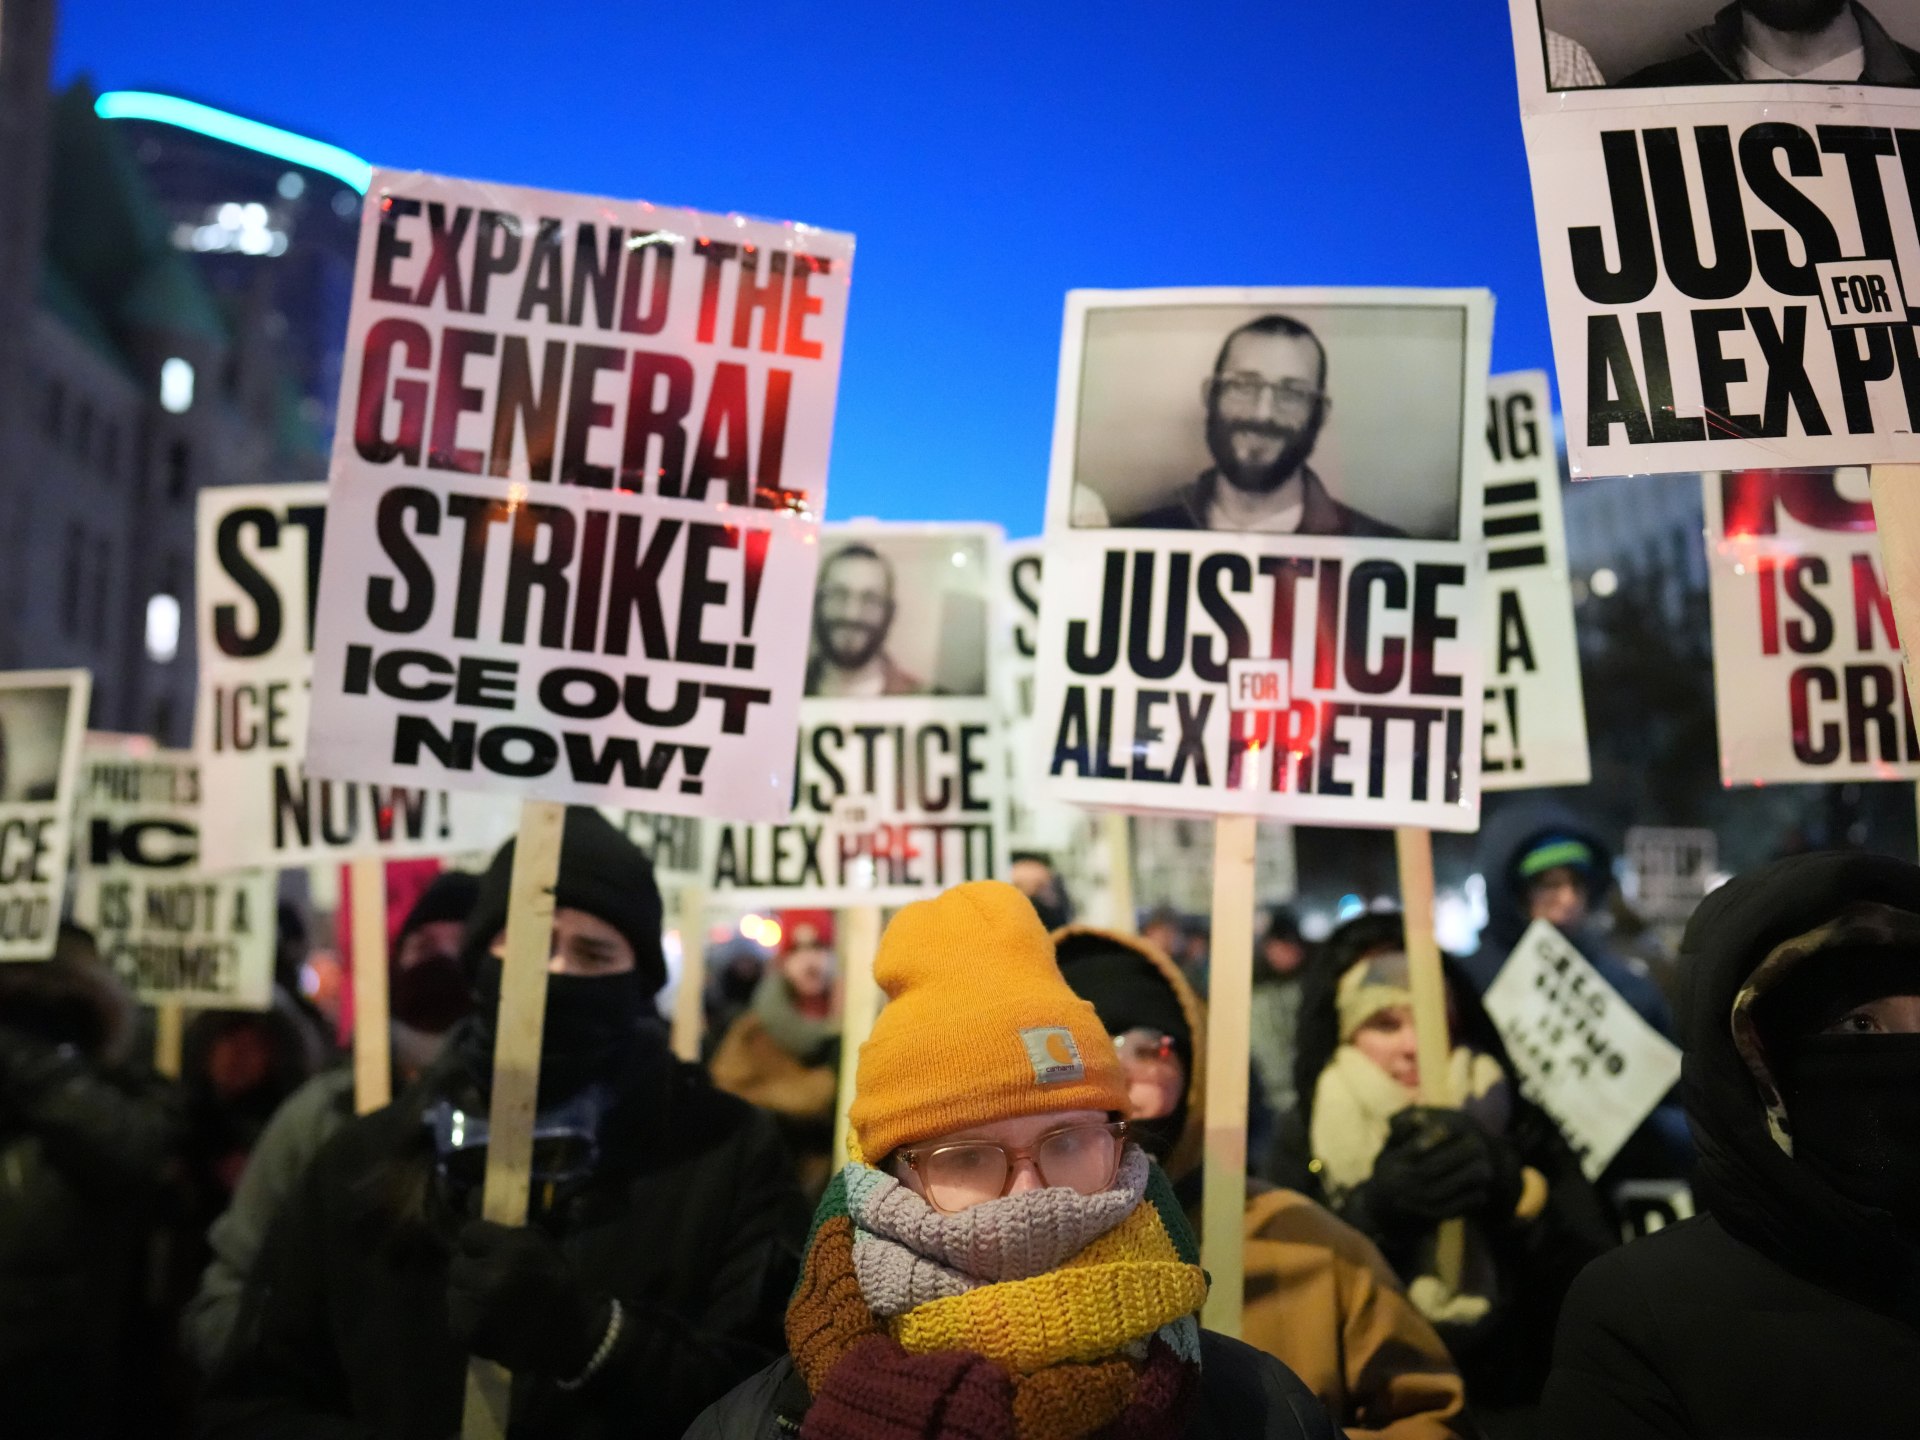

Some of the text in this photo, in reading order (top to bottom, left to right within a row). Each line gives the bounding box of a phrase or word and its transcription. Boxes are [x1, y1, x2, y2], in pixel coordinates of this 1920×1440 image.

[1568, 122, 1920, 304] JUST
[370, 194, 831, 360] EXPAND THE
[1831, 274, 1893, 315] FOR
[354, 317, 808, 511] GENERAL
[1587, 306, 1833, 447] ALEX
[214, 503, 326, 658] ST
[366, 485, 772, 670] STRIKE!
[1758, 553, 1901, 656] IS N
[1066, 549, 1466, 698] JUSTICE
[1498, 587, 1538, 675] A
[214, 680, 289, 753] ICE
[343, 644, 771, 735] ICE OUT
[1239, 672, 1280, 701] FOR
[1482, 687, 1525, 773] E!
[392, 715, 711, 796] NOW!
[792, 725, 990, 813] STICE
[1050, 685, 1215, 787] ALEX
[1226, 701, 1465, 806] PRETTI
[0, 817, 55, 884] CE
[90, 816, 199, 869] IC
[713, 823, 995, 889] ALEX PRETTI
[1045, 1064, 1075, 1073] carhartt
